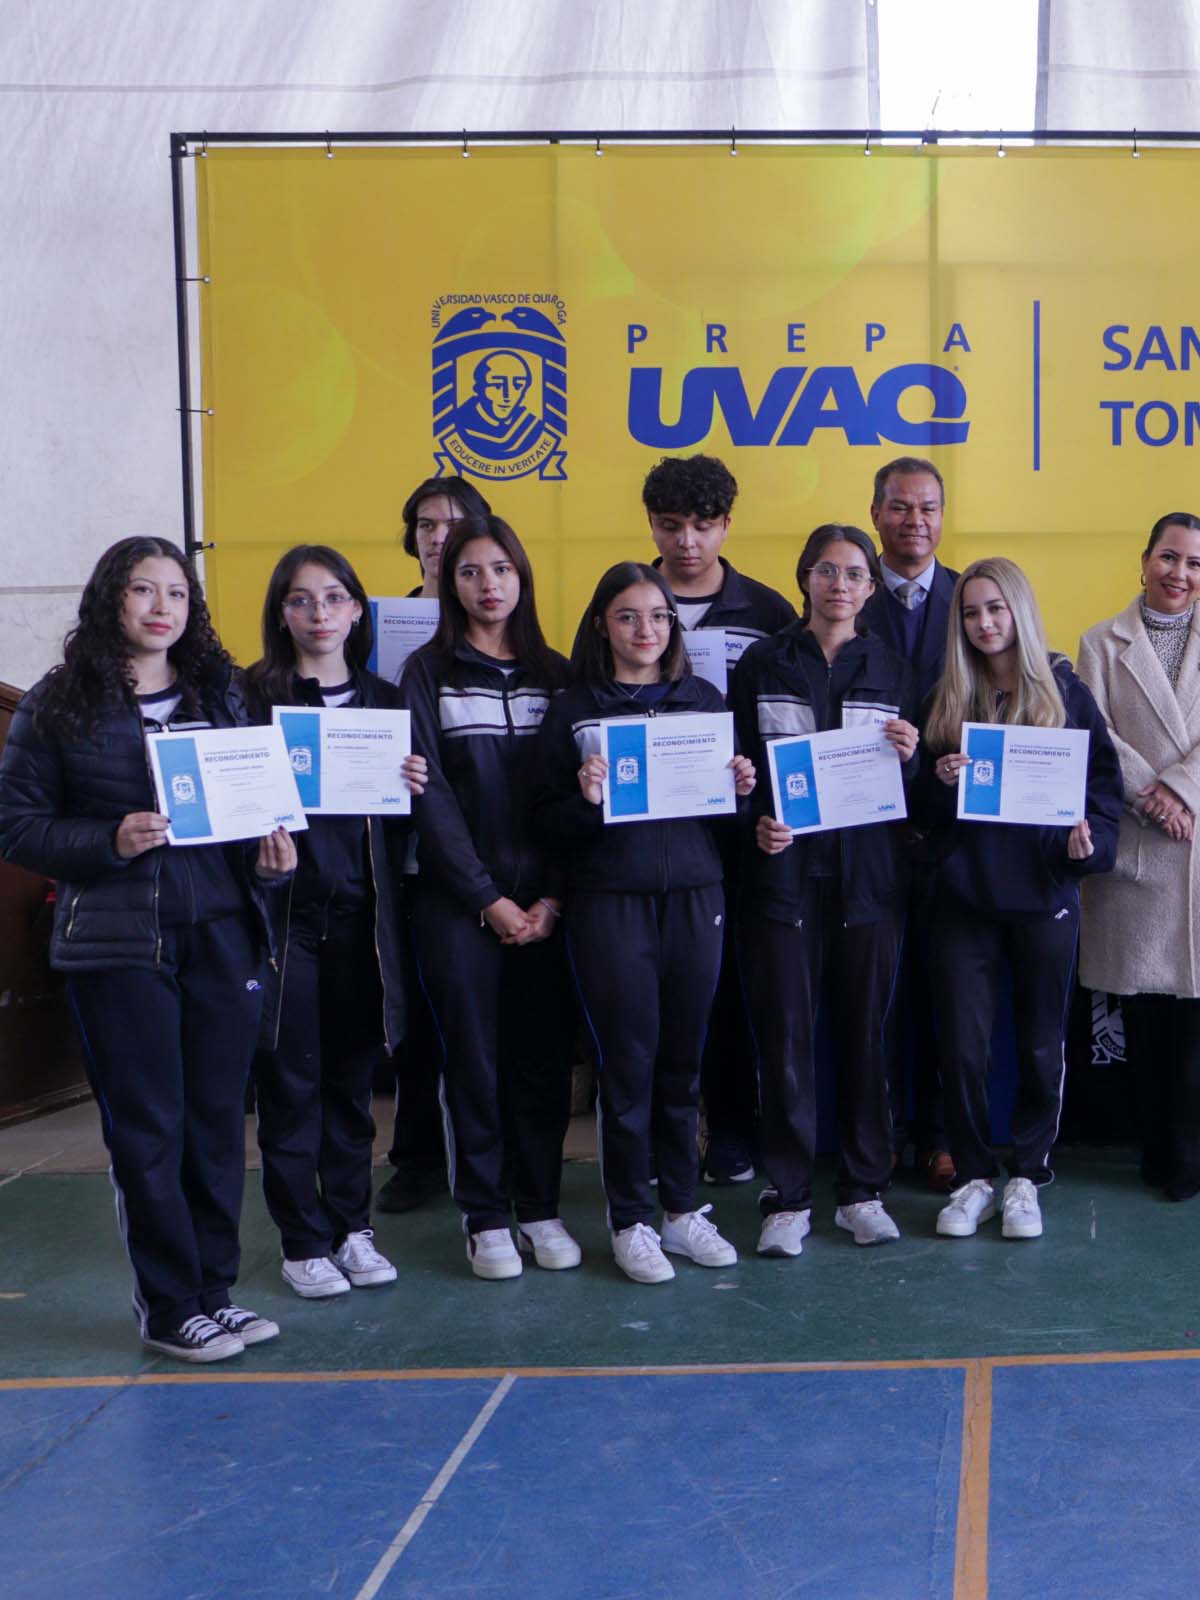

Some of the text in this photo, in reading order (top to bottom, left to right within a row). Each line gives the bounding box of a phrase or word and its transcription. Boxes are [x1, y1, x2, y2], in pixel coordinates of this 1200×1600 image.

[432, 294, 567, 328] UNIVERSIDAD VASCO DE QUIROGA
[627, 323, 971, 354] PREPA
[627, 363, 970, 449] UVAQ
[450, 438, 552, 474] EDUCERE IN VERITATE
[327, 731, 393, 741] RECONOCIMIENTO
[652, 737, 717, 748] RECONOCIMIENTO
[204, 751, 270, 763] RECONOCIMIENTO
[818, 746, 881, 761] RECONOCIMIENTO
[1009, 748, 1071, 758] RECONOCIMIENTO
